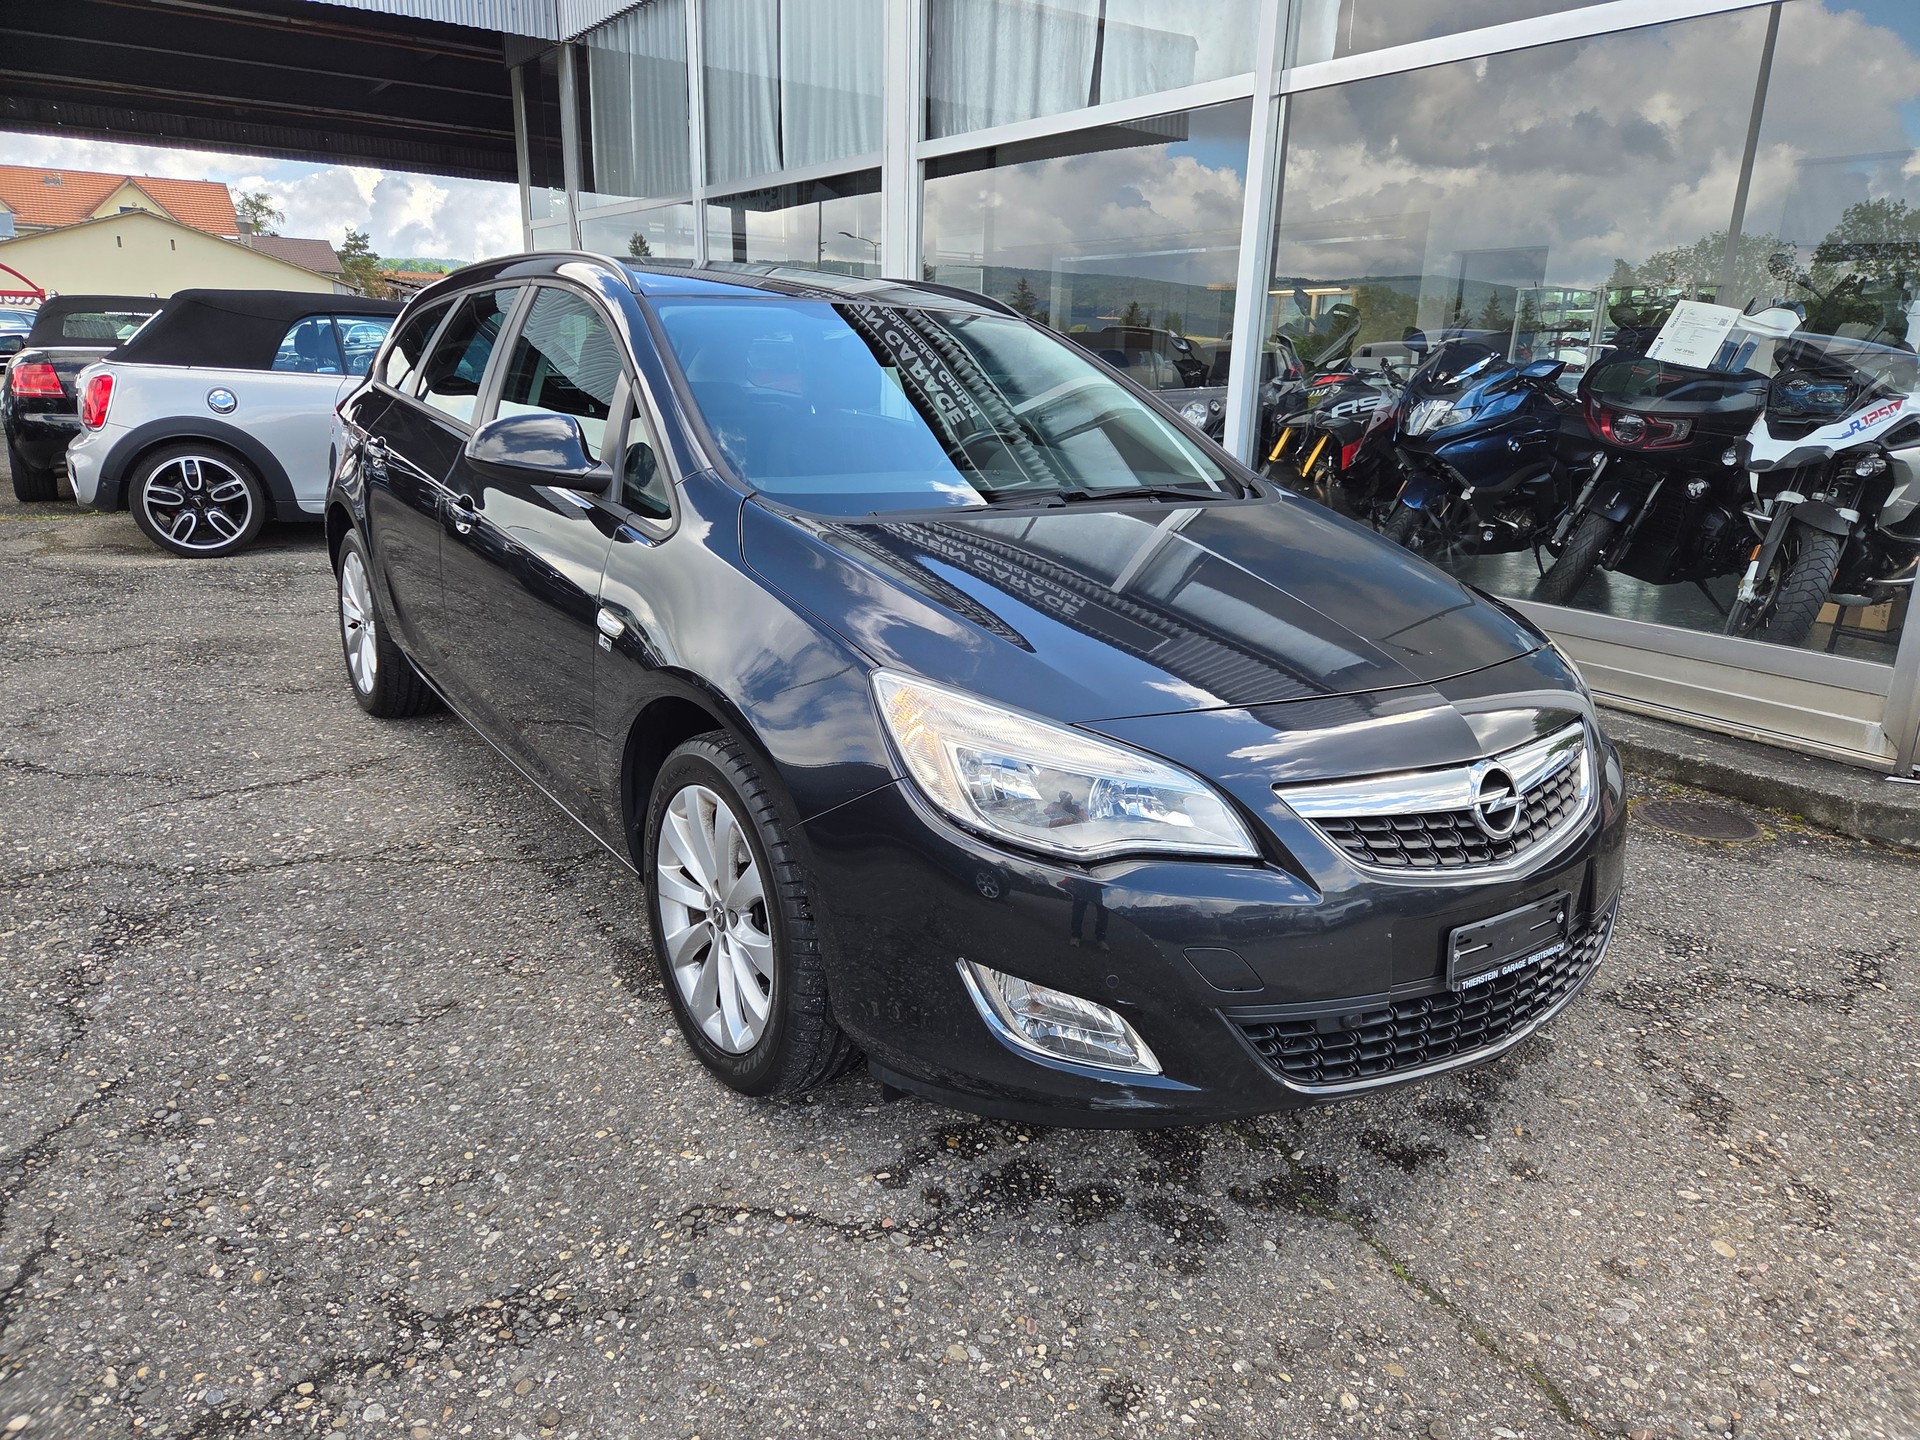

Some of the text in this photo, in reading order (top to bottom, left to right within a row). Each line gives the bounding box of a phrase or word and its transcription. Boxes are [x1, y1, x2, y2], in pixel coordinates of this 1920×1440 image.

[1462, 942, 1566, 990] THIERSTEIN GARAGE BREITENBACH
